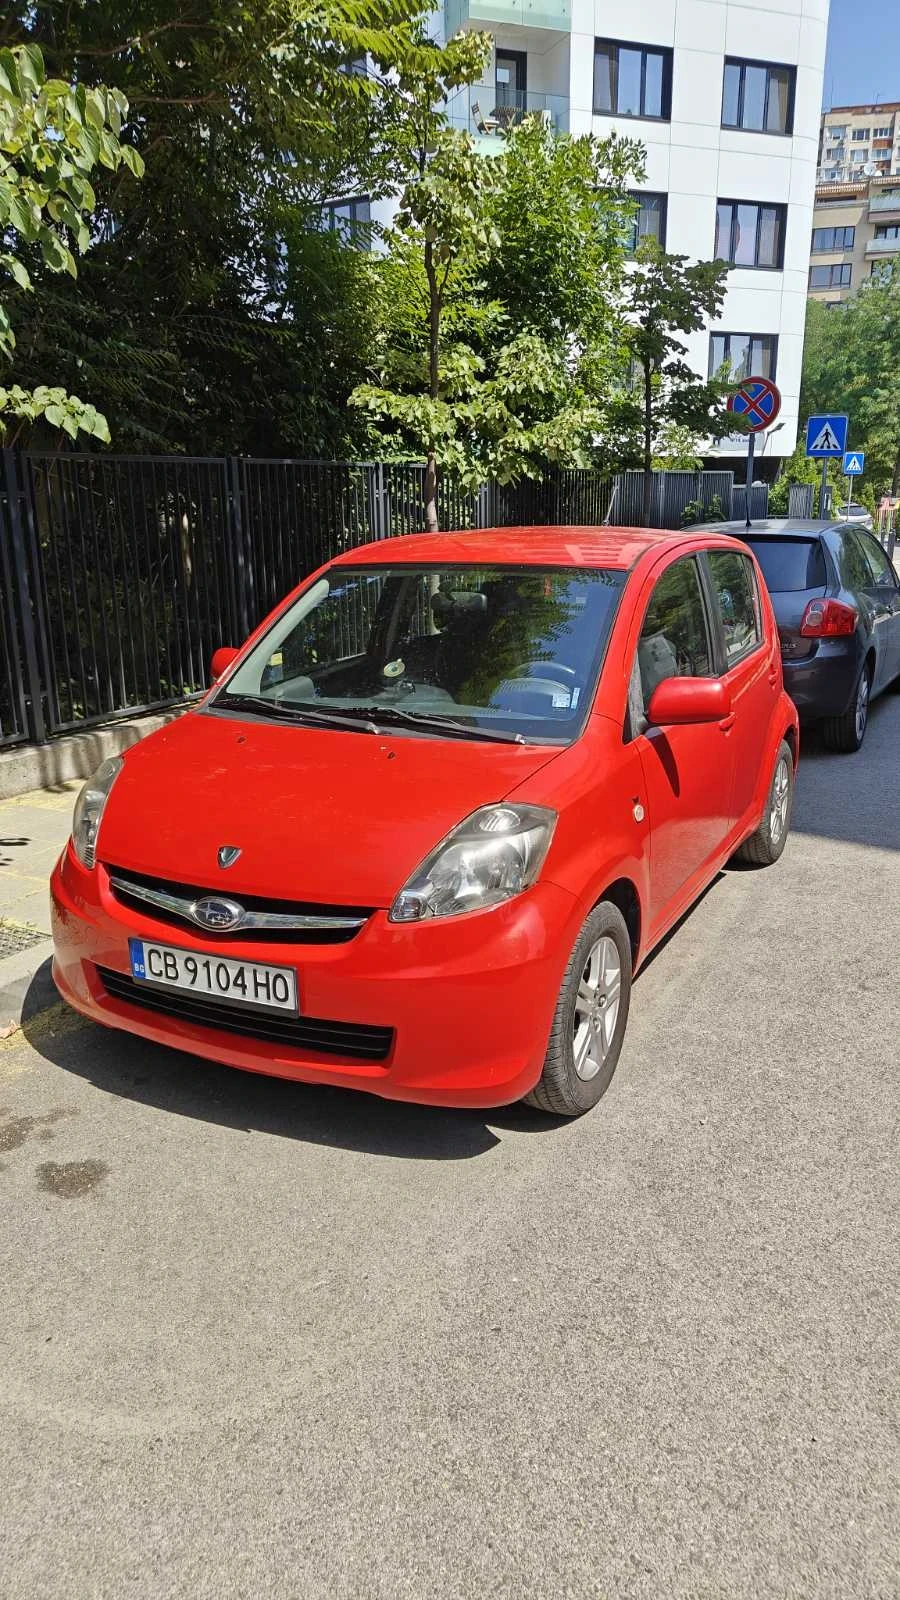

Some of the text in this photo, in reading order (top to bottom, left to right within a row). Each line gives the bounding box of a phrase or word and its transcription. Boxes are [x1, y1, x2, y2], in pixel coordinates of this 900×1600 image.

[134, 963, 145, 973] BG
[148, 949, 289, 1002] CB 9104 HO
